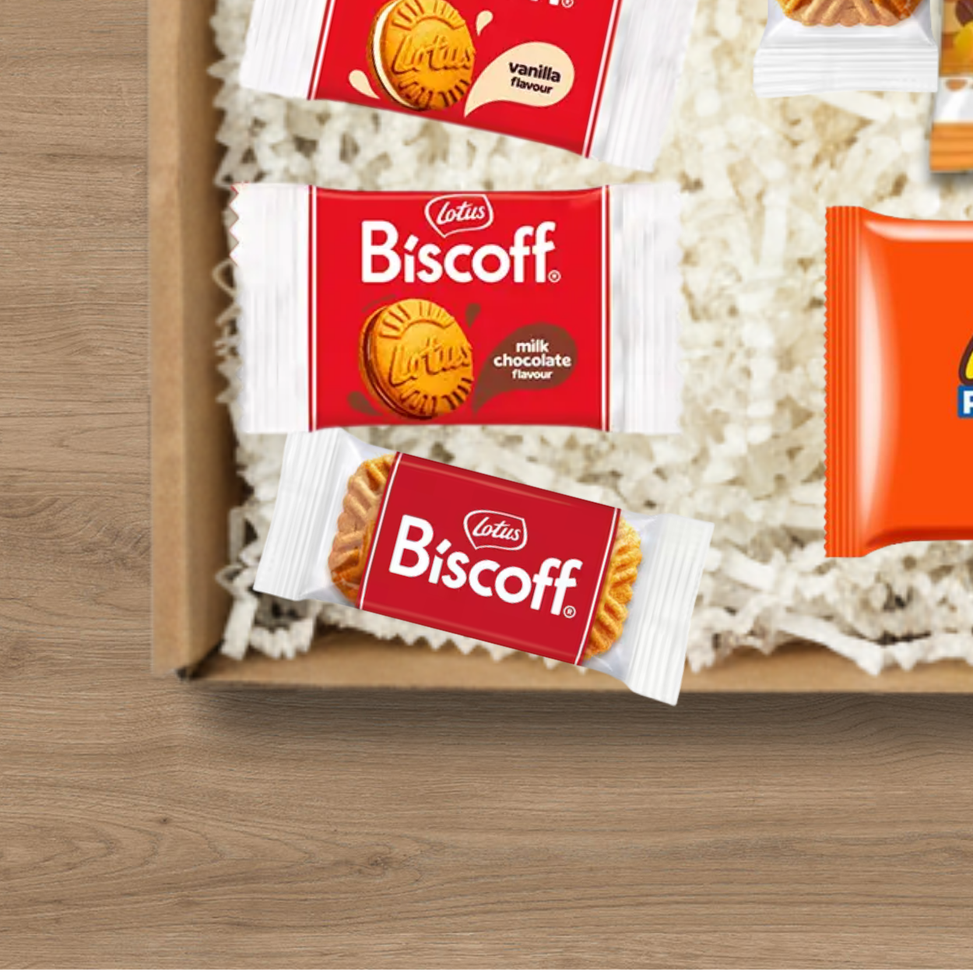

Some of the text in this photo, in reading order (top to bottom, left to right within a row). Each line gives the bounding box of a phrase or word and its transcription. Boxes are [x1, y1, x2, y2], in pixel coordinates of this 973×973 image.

[509, 62, 562, 83] vanilla
[511, 76, 554, 94] flavour
[437, 199, 486, 225] Lotus
[361, 220, 556, 284] Biscoff
[516, 338, 550, 353] milk
[493, 353, 572, 367] chocolate
[512, 368, 553, 379] flavour
[471, 515, 522, 543] Lotus
[388, 514, 583, 617] Biscoff
